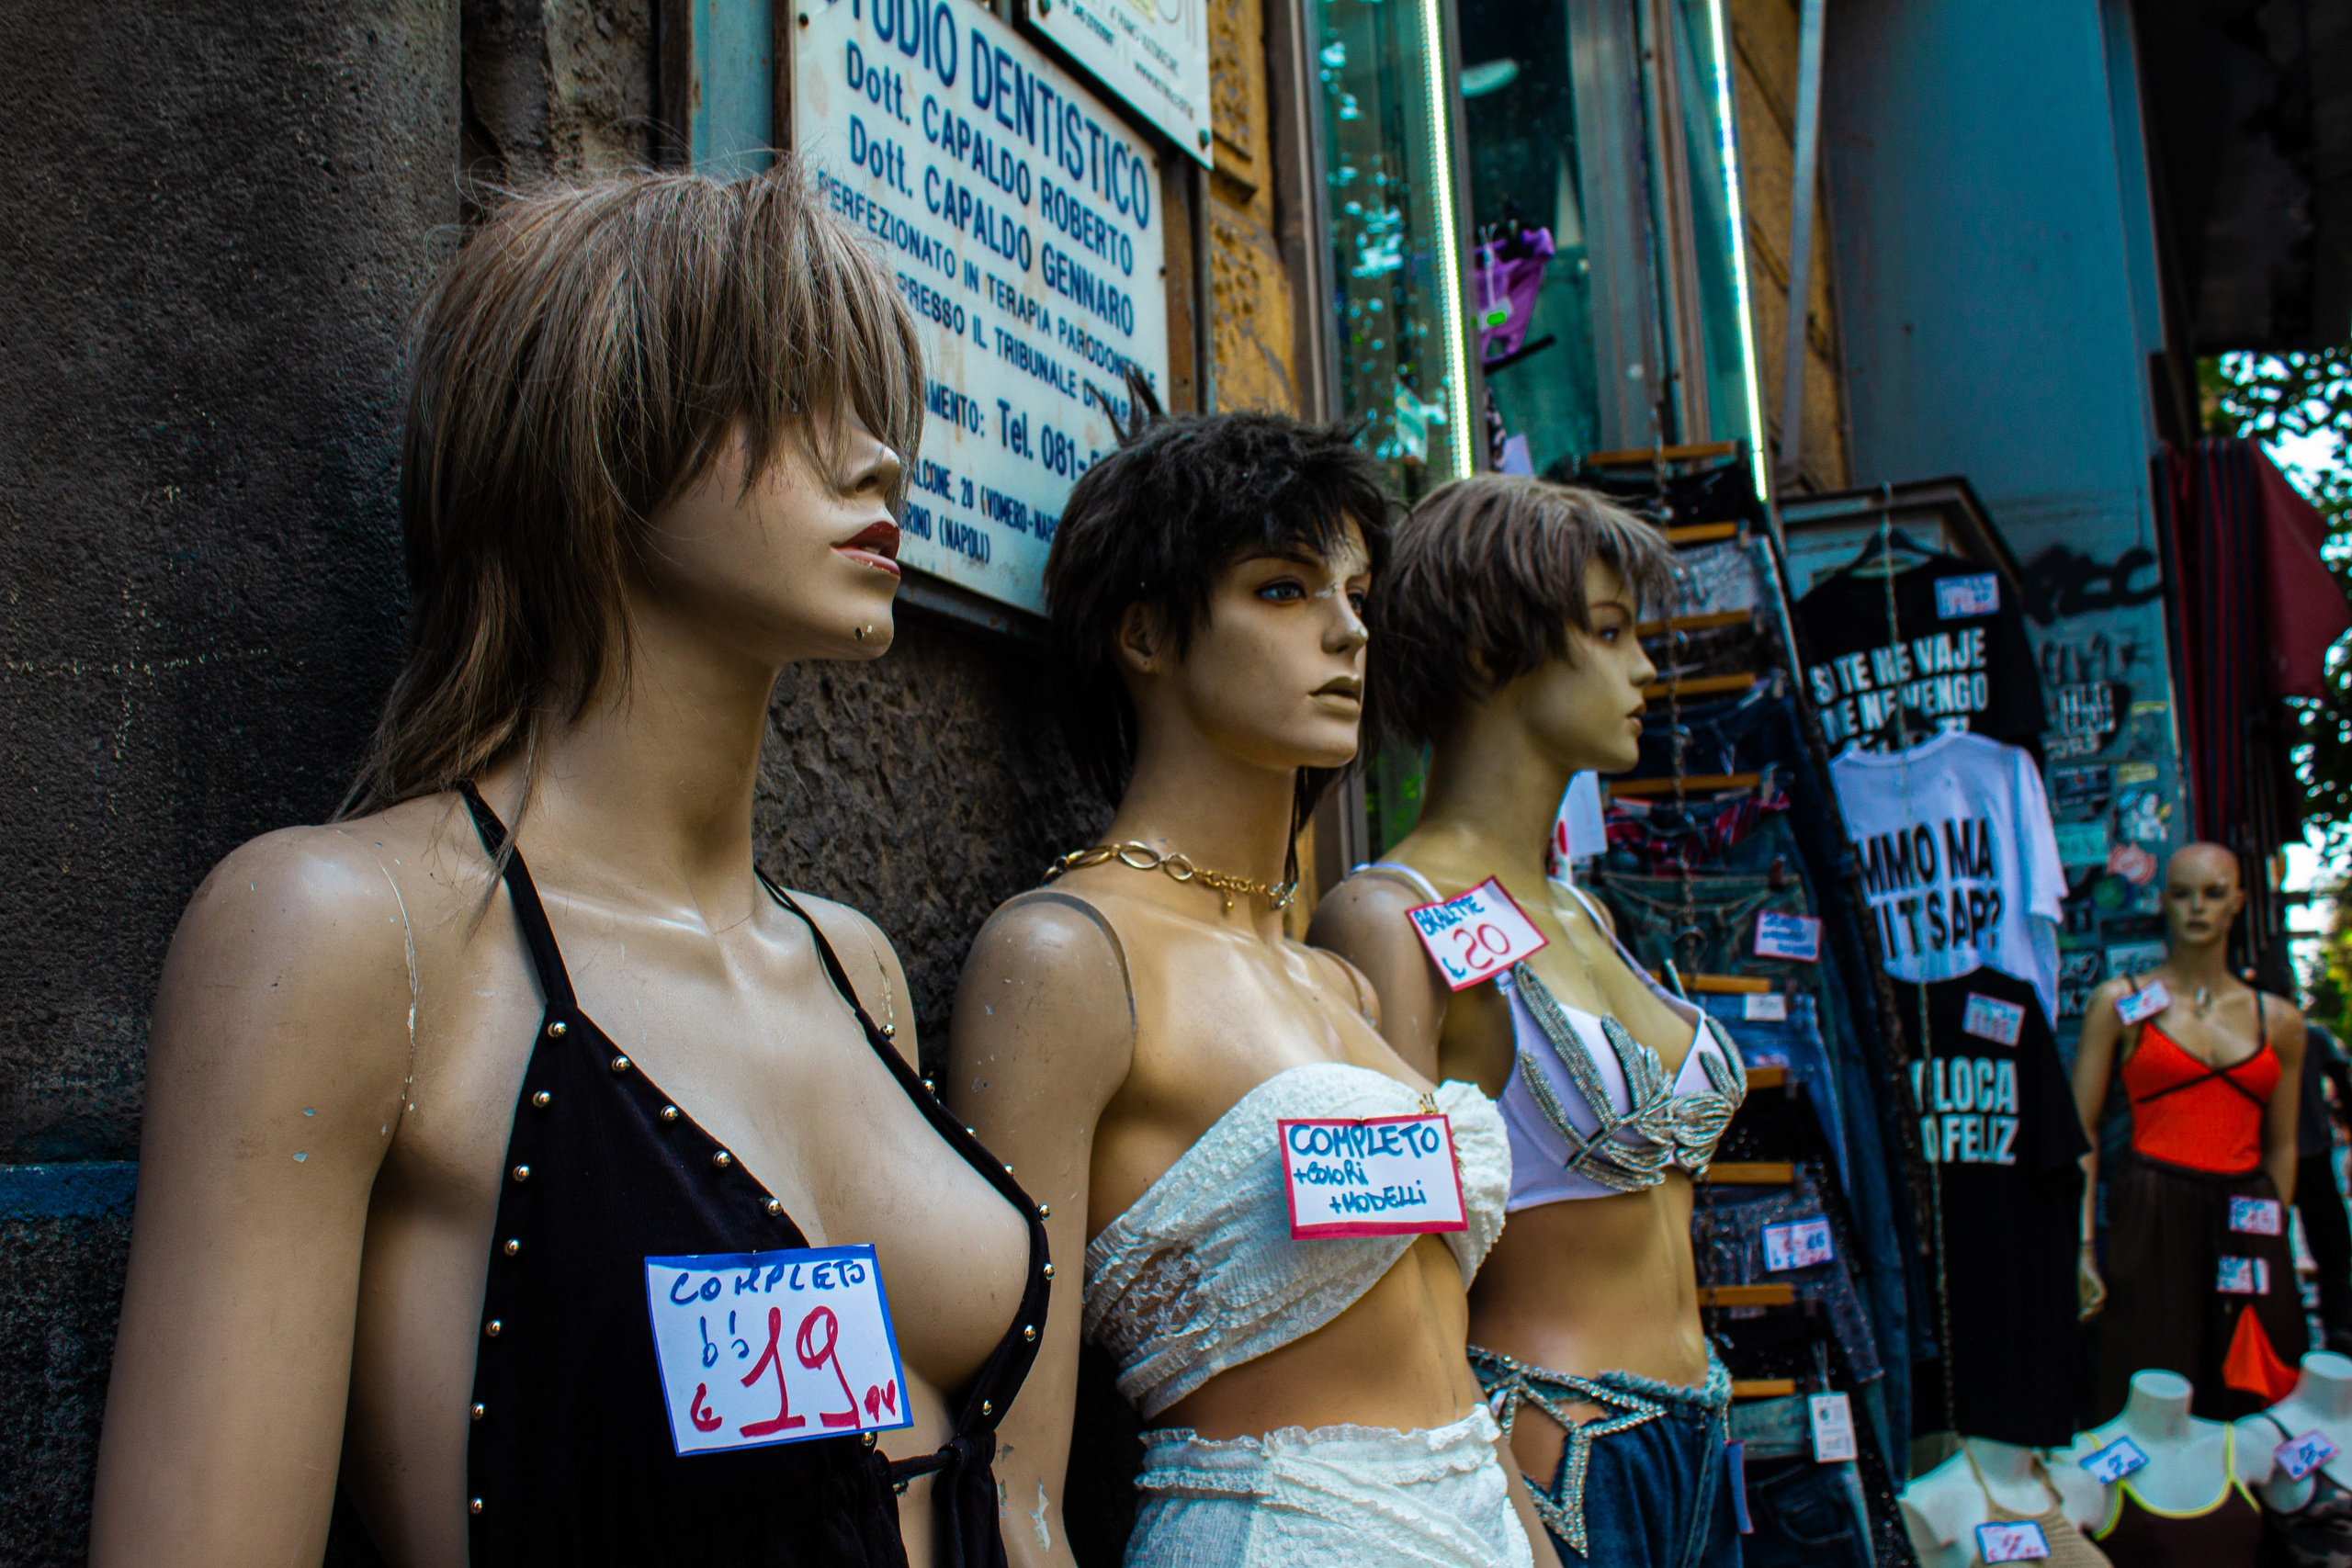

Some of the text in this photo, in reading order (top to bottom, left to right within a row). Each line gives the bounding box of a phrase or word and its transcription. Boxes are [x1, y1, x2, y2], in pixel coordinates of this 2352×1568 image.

[828, 0, 956, 87] UDIO
[971, 28, 1149, 230] DENTISTICO
[847, 39, 1133, 276] Dott. CAPALDO ROBERTO
[850, 114, 1134, 337] Dott. CAPALDO GENNARO
[964, 259, 979, 294] IN
[987, 272, 1051, 337] TERAPIA
[1058, 316, 1156, 390] PARODONE
[973, 314, 988, 349] IL
[995, 326, 1077, 400] TRIBUNALE
[997, 398, 1034, 460] Tel.
[960, 477, 974, 510] 20
[939, 514, 991, 564] (NAPOLI)
[1833, 651, 1873, 694] TE
[1912, 626, 1987, 676] VAJE
[1453, 923, 1510, 970] 20
[1932, 1055, 2019, 1115] LOCA
[1289, 1122, 1441, 1159] COMPLETO
[1940, 1112, 2019, 1166] FELIZ
[669, 1259, 865, 1306] COMPLETO
[740, 1304, 862, 1438] 19
